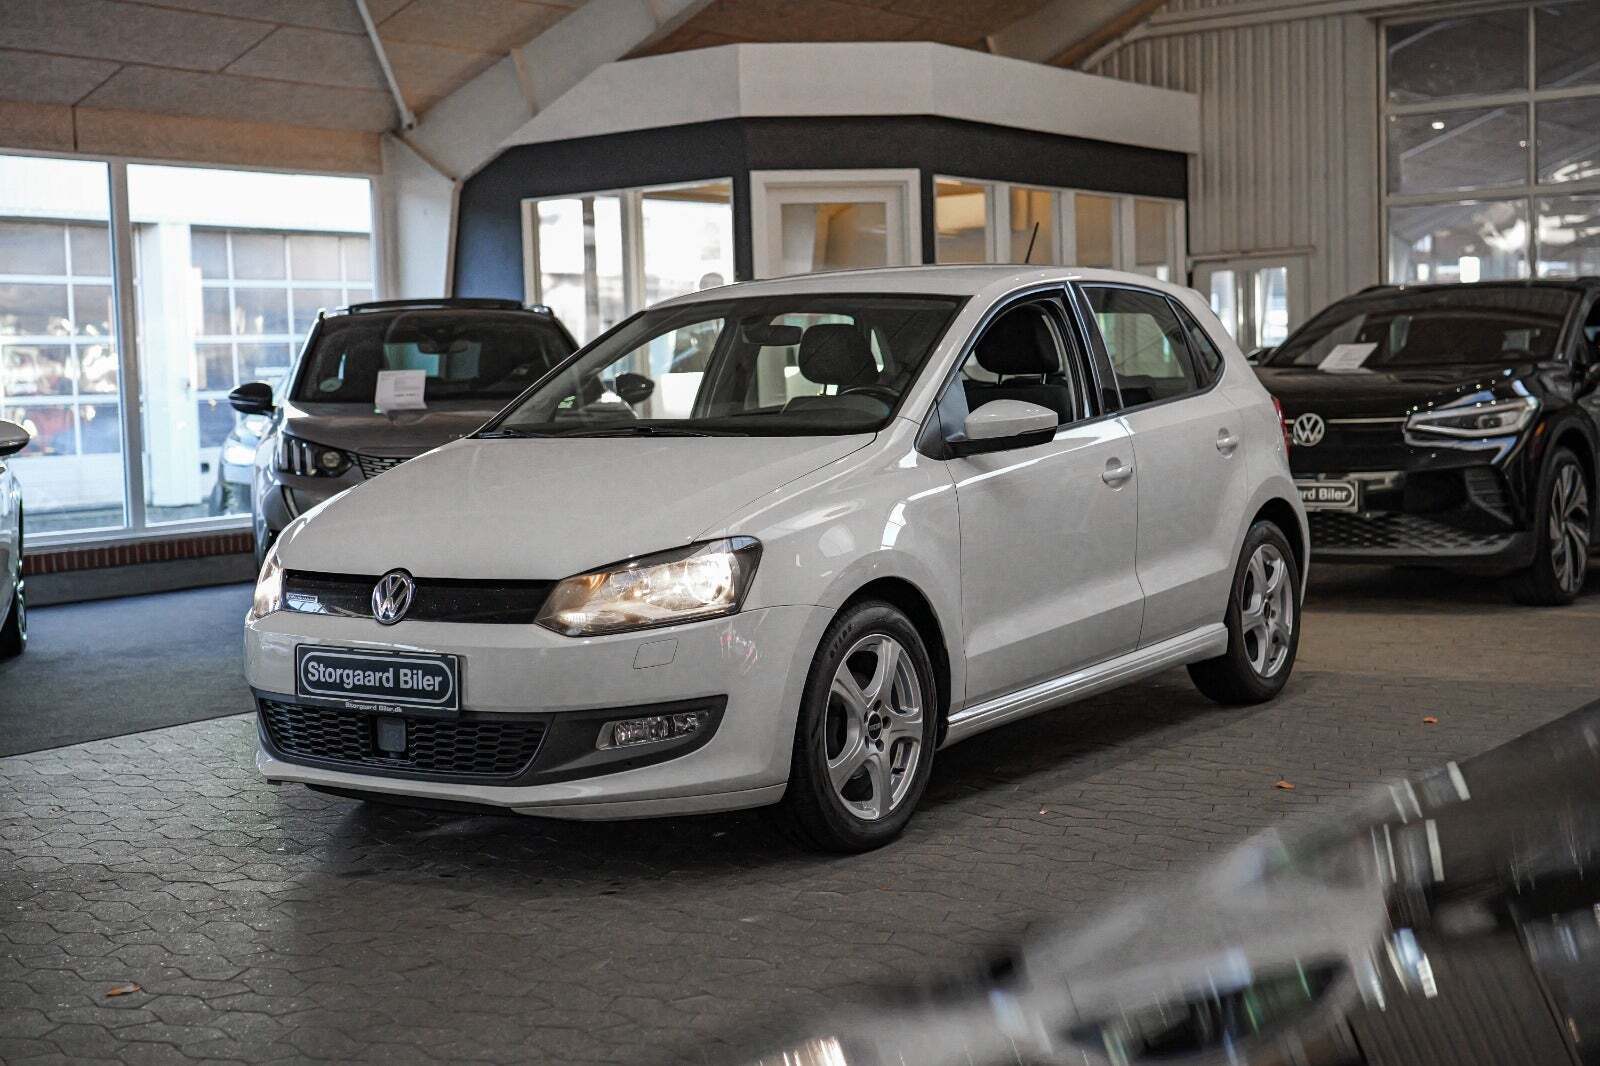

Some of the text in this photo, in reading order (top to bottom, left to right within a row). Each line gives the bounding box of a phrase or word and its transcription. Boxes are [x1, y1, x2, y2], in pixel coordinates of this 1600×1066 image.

[1319, 487, 1348, 500] Biler
[307, 661, 443, 691] Storgaard Biler
